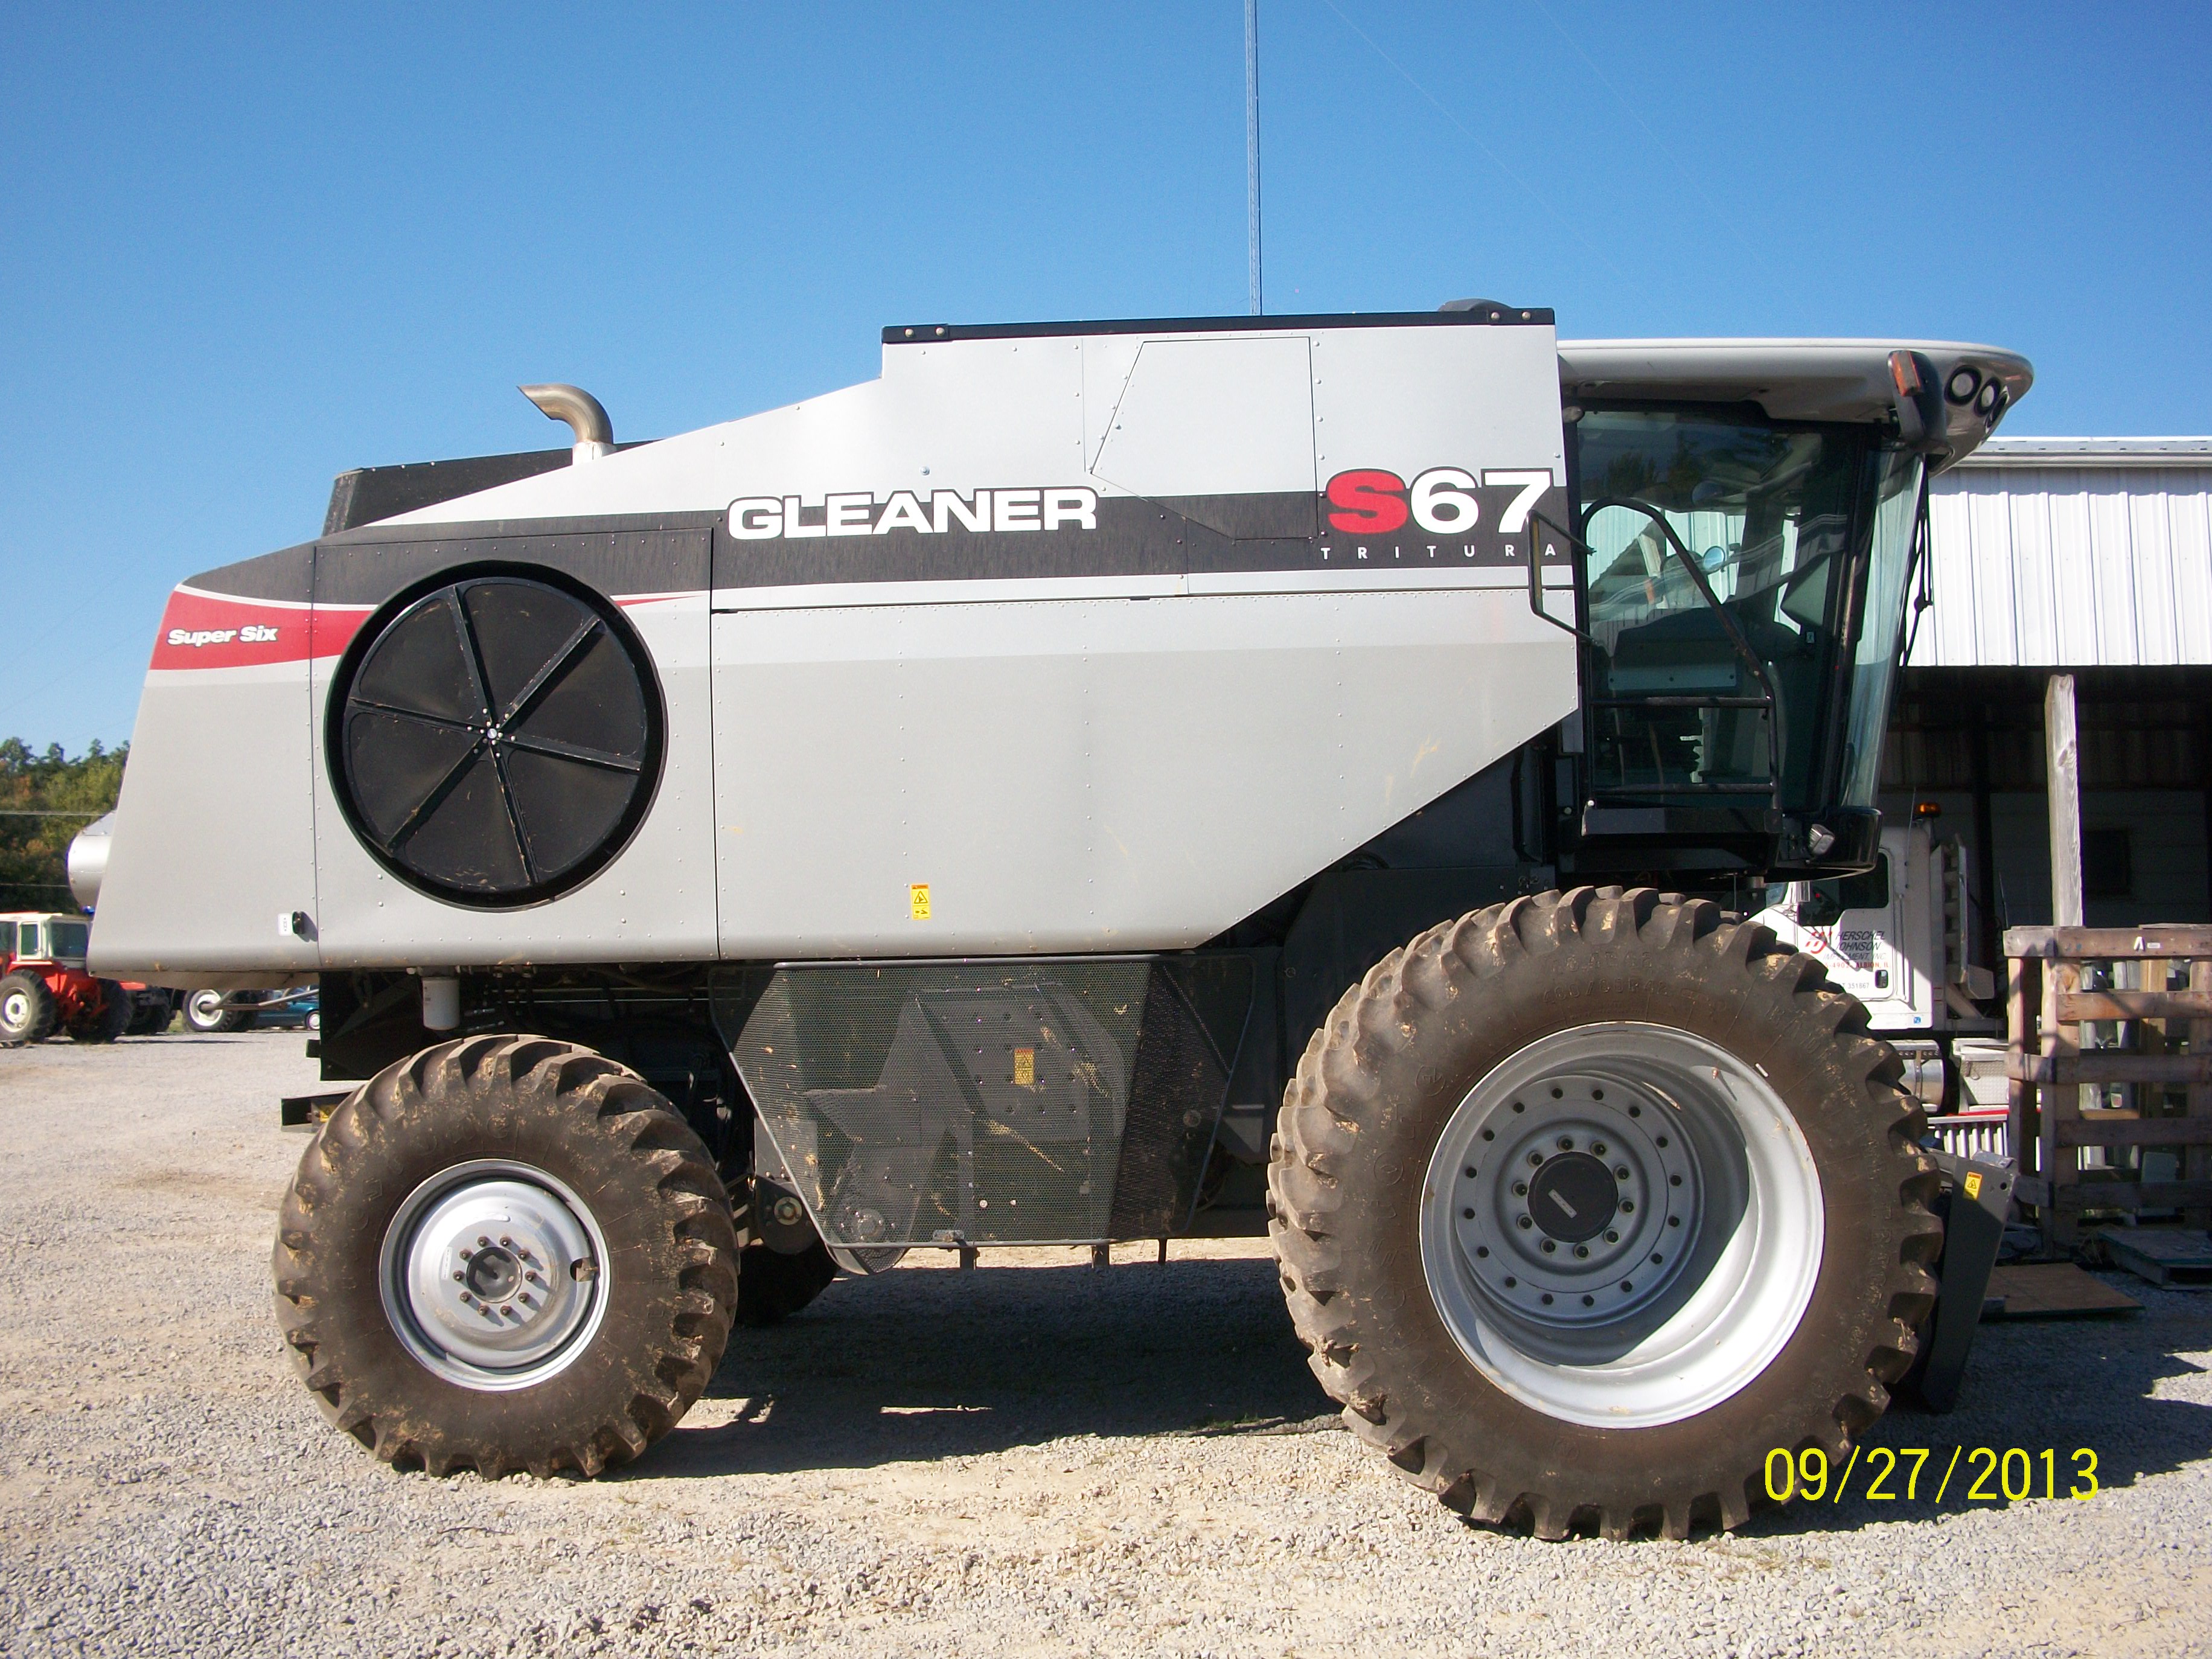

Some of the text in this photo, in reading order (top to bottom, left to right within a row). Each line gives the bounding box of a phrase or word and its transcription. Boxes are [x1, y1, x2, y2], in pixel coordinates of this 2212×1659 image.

[1327, 468, 1552, 534] S67
[728, 488, 1097, 540] GLEANER
[1320, 543, 1556, 560] TRITURA
[168, 625, 278, 647] Super Six
[1835, 931, 1885, 941] HERSCHEL
[1835, 942, 1882, 951] JOHNSON
